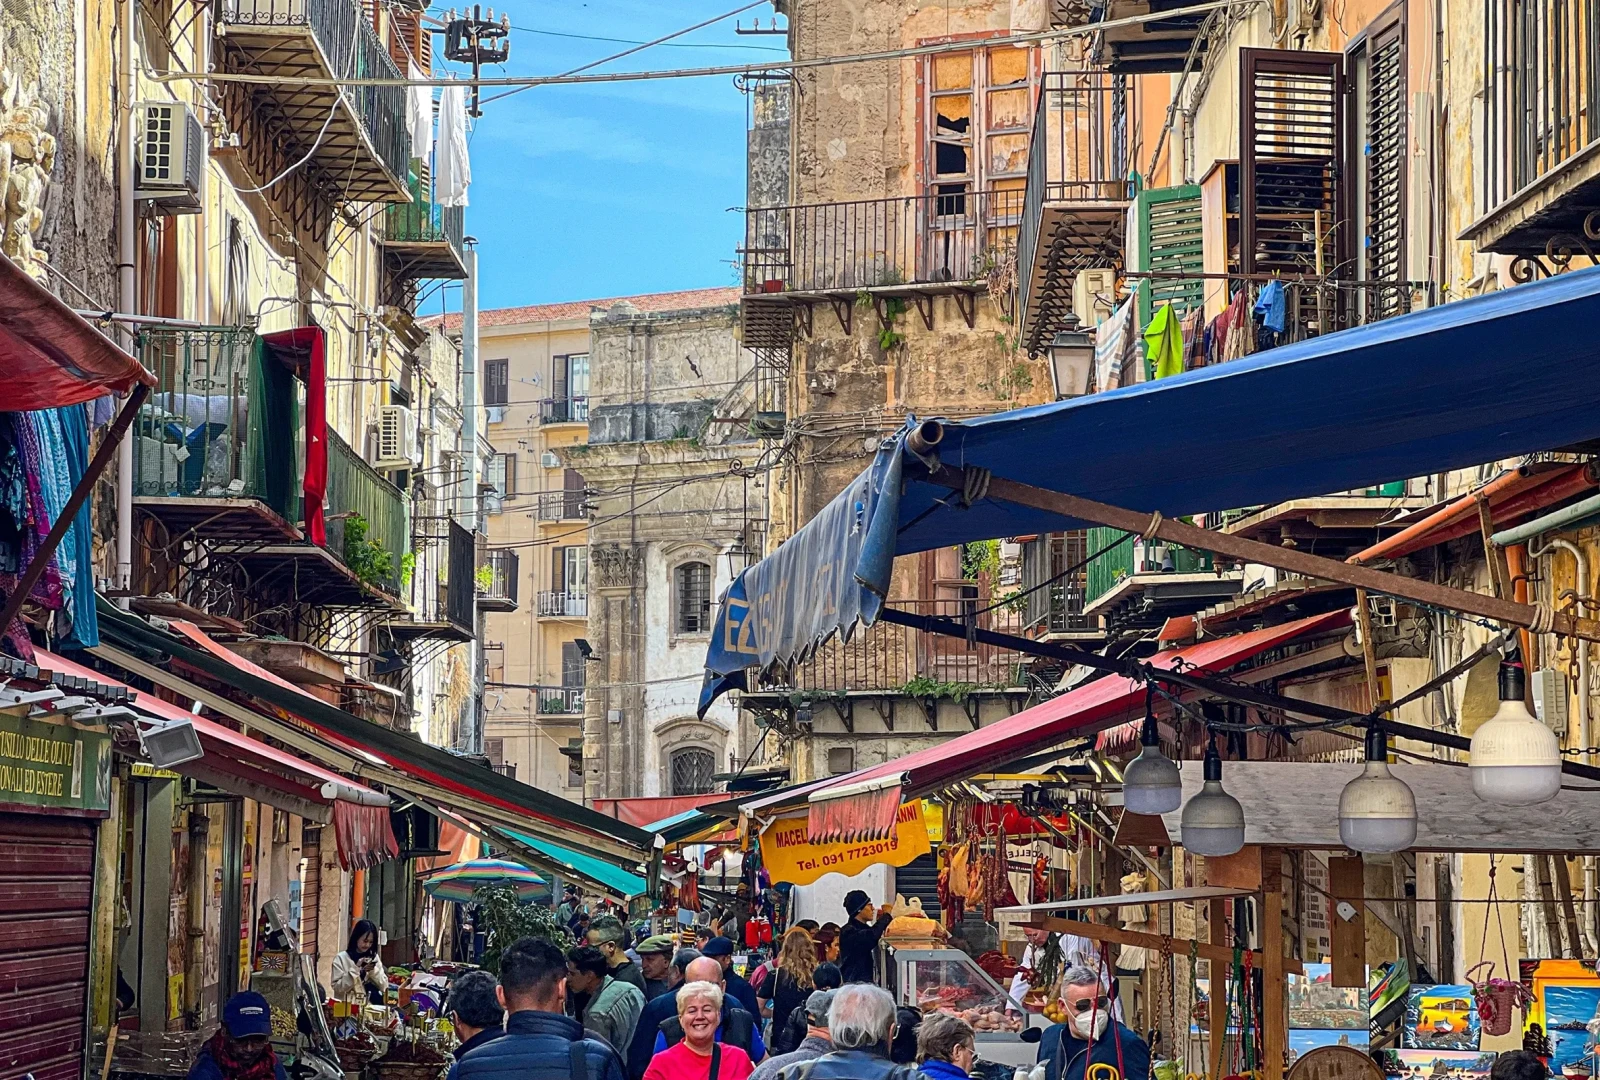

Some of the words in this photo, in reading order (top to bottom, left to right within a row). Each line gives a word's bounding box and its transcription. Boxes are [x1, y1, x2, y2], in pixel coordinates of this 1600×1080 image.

[26, 736, 51, 763] DELLE
[51, 741, 73, 767] OLIVE
[24, 769, 35, 794] ED
[36, 771, 64, 797] ESTERE
[896, 804, 918, 824] ANNI
[797, 860, 820, 871] Tel.
[822, 853, 844, 866] 091
[847, 840, 898, 861] 7723019
